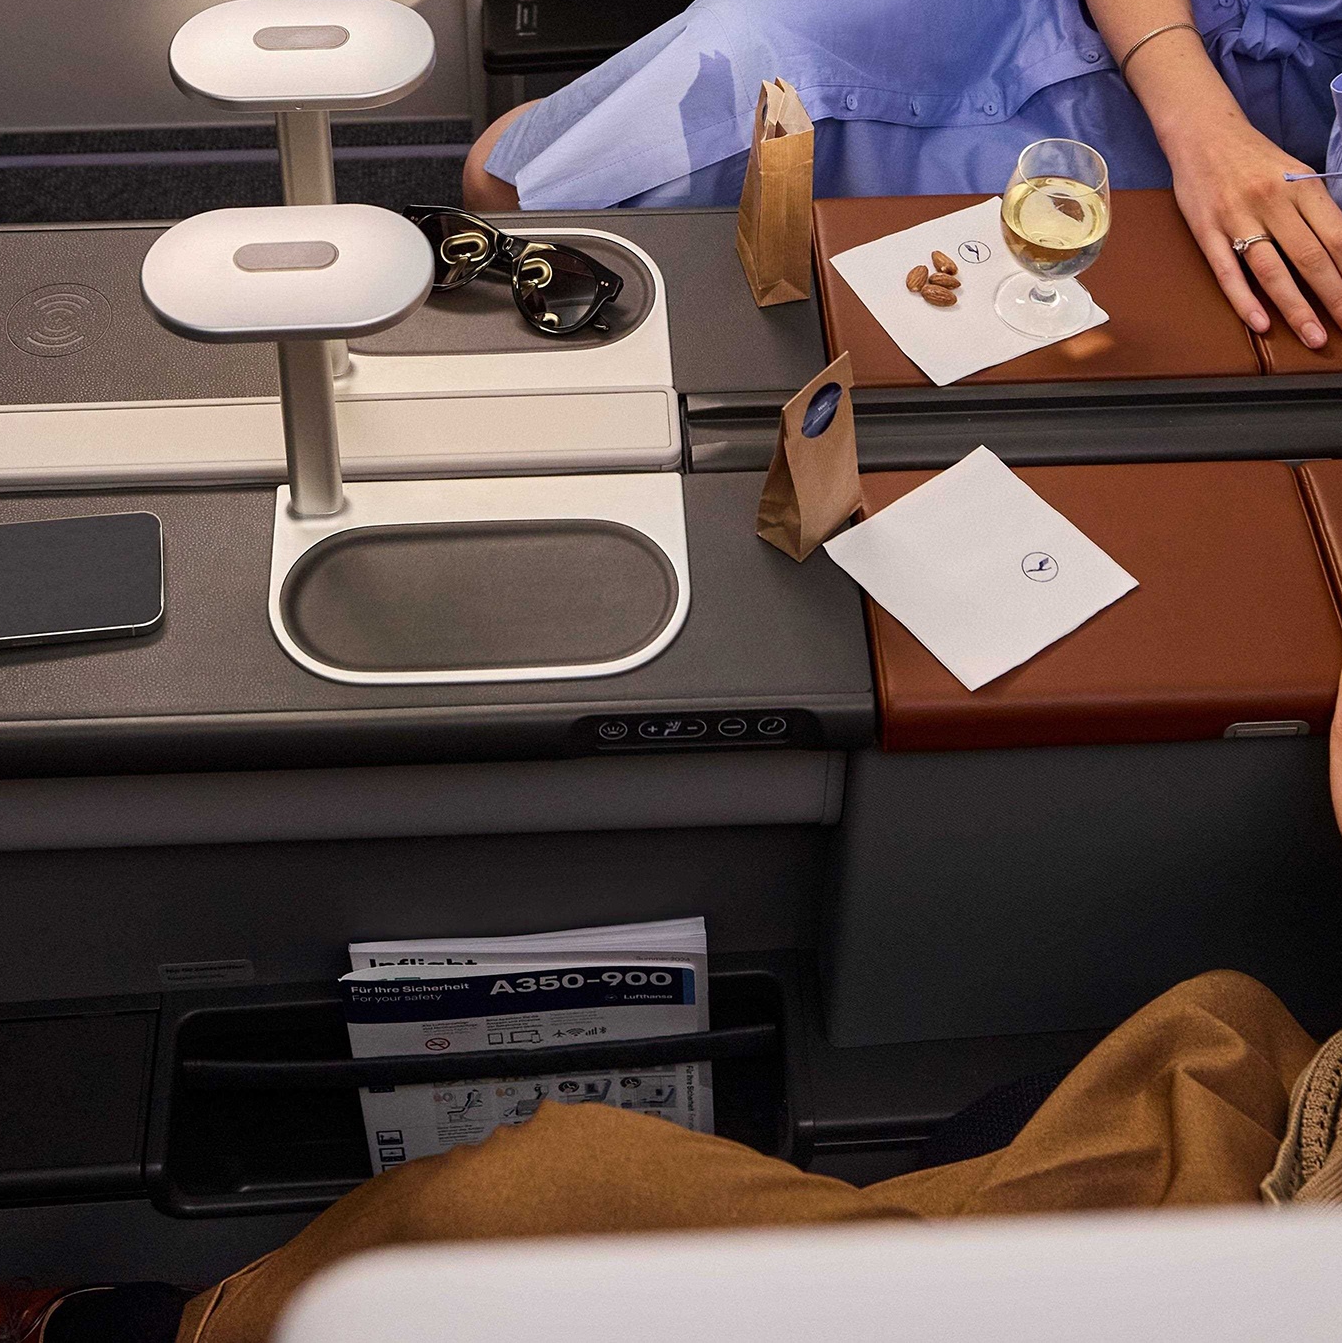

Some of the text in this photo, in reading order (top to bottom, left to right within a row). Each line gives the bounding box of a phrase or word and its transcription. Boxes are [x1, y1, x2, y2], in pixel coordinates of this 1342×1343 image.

[351, 986, 372, 994] Für
[403, 983, 469, 993] Sicherheit
[490, 971, 673, 996] A350-900
[375, 995, 401, 1003] your
[405, 993, 442, 1001] safety
